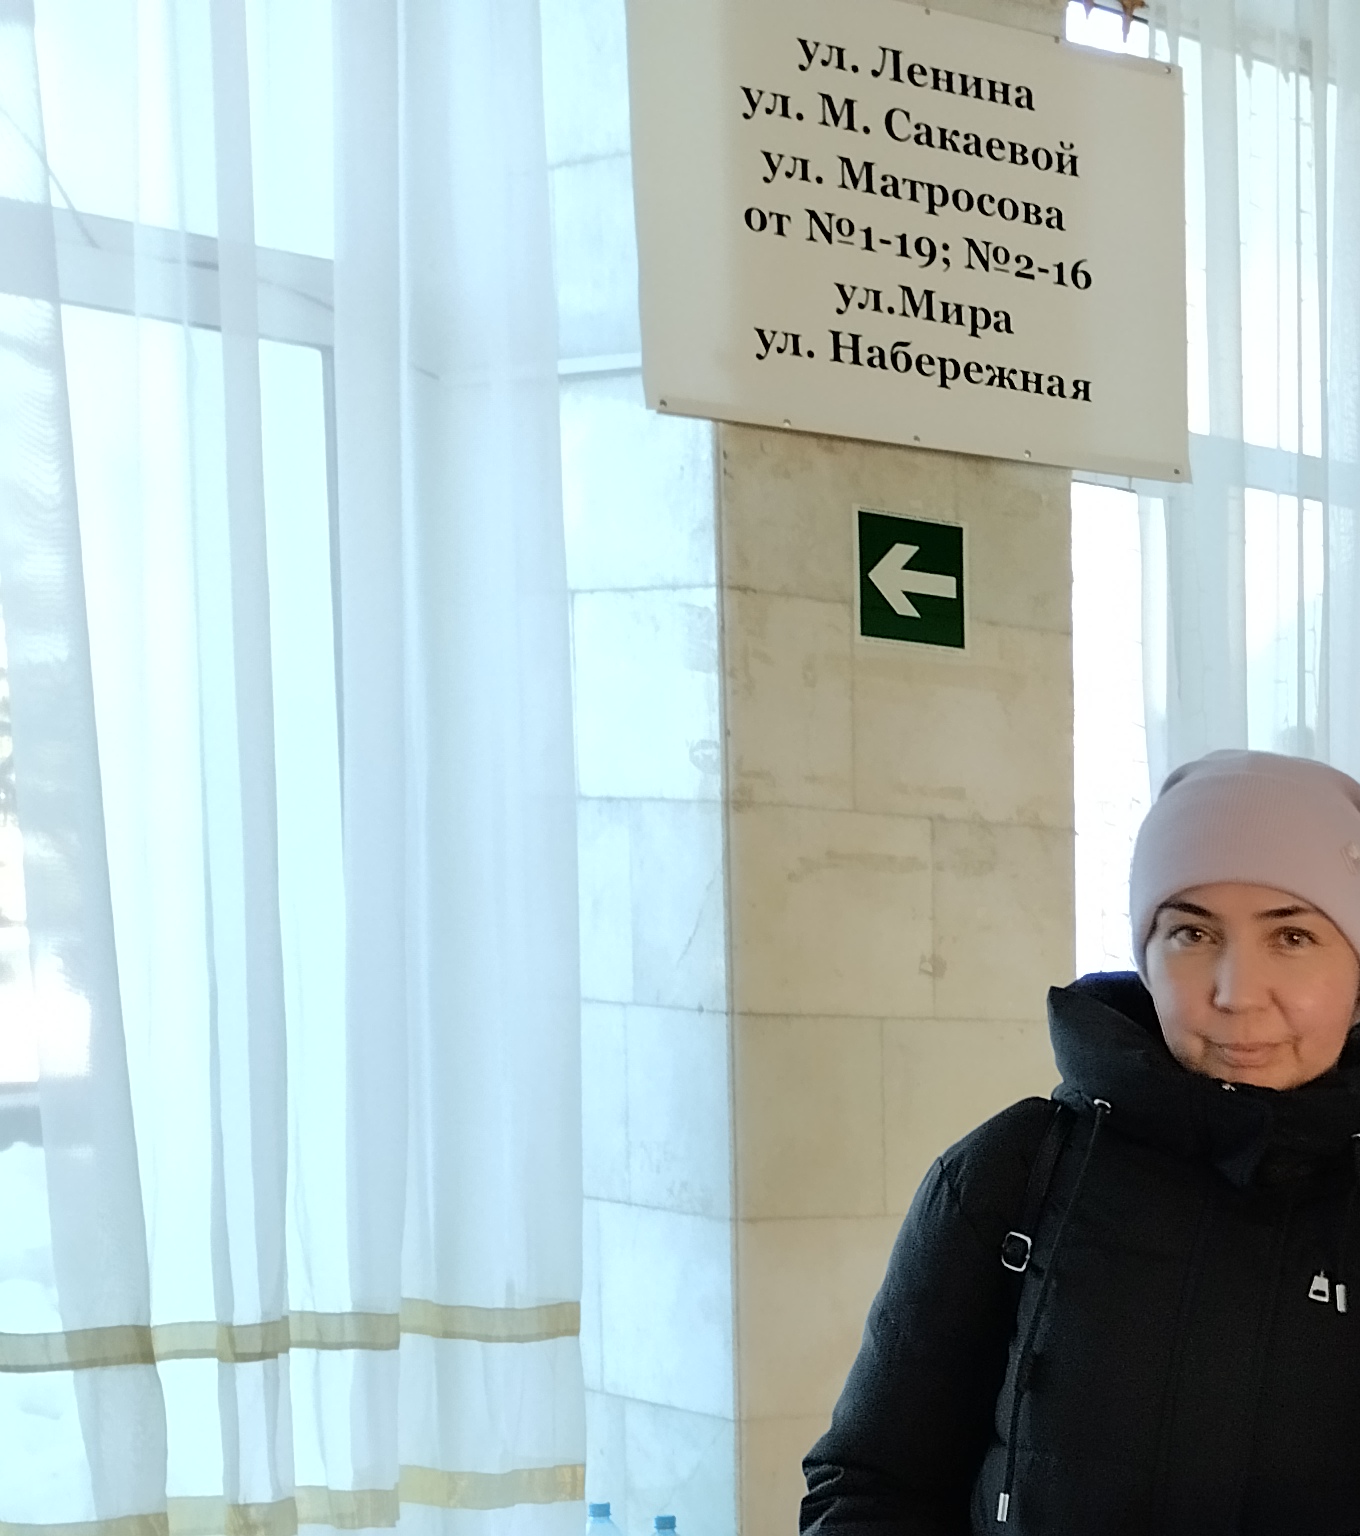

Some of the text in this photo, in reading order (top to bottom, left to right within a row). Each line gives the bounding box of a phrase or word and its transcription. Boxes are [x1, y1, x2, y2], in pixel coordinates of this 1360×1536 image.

[796, 37, 1036, 112] ул. Ленина
[739, 85, 1079, 178] ул. М. Сакаевой
[744, 207, 792, 238] от
[760, 150, 1066, 232] ул. Матросова
[753, 327, 1092, 403] ул. Набережная
